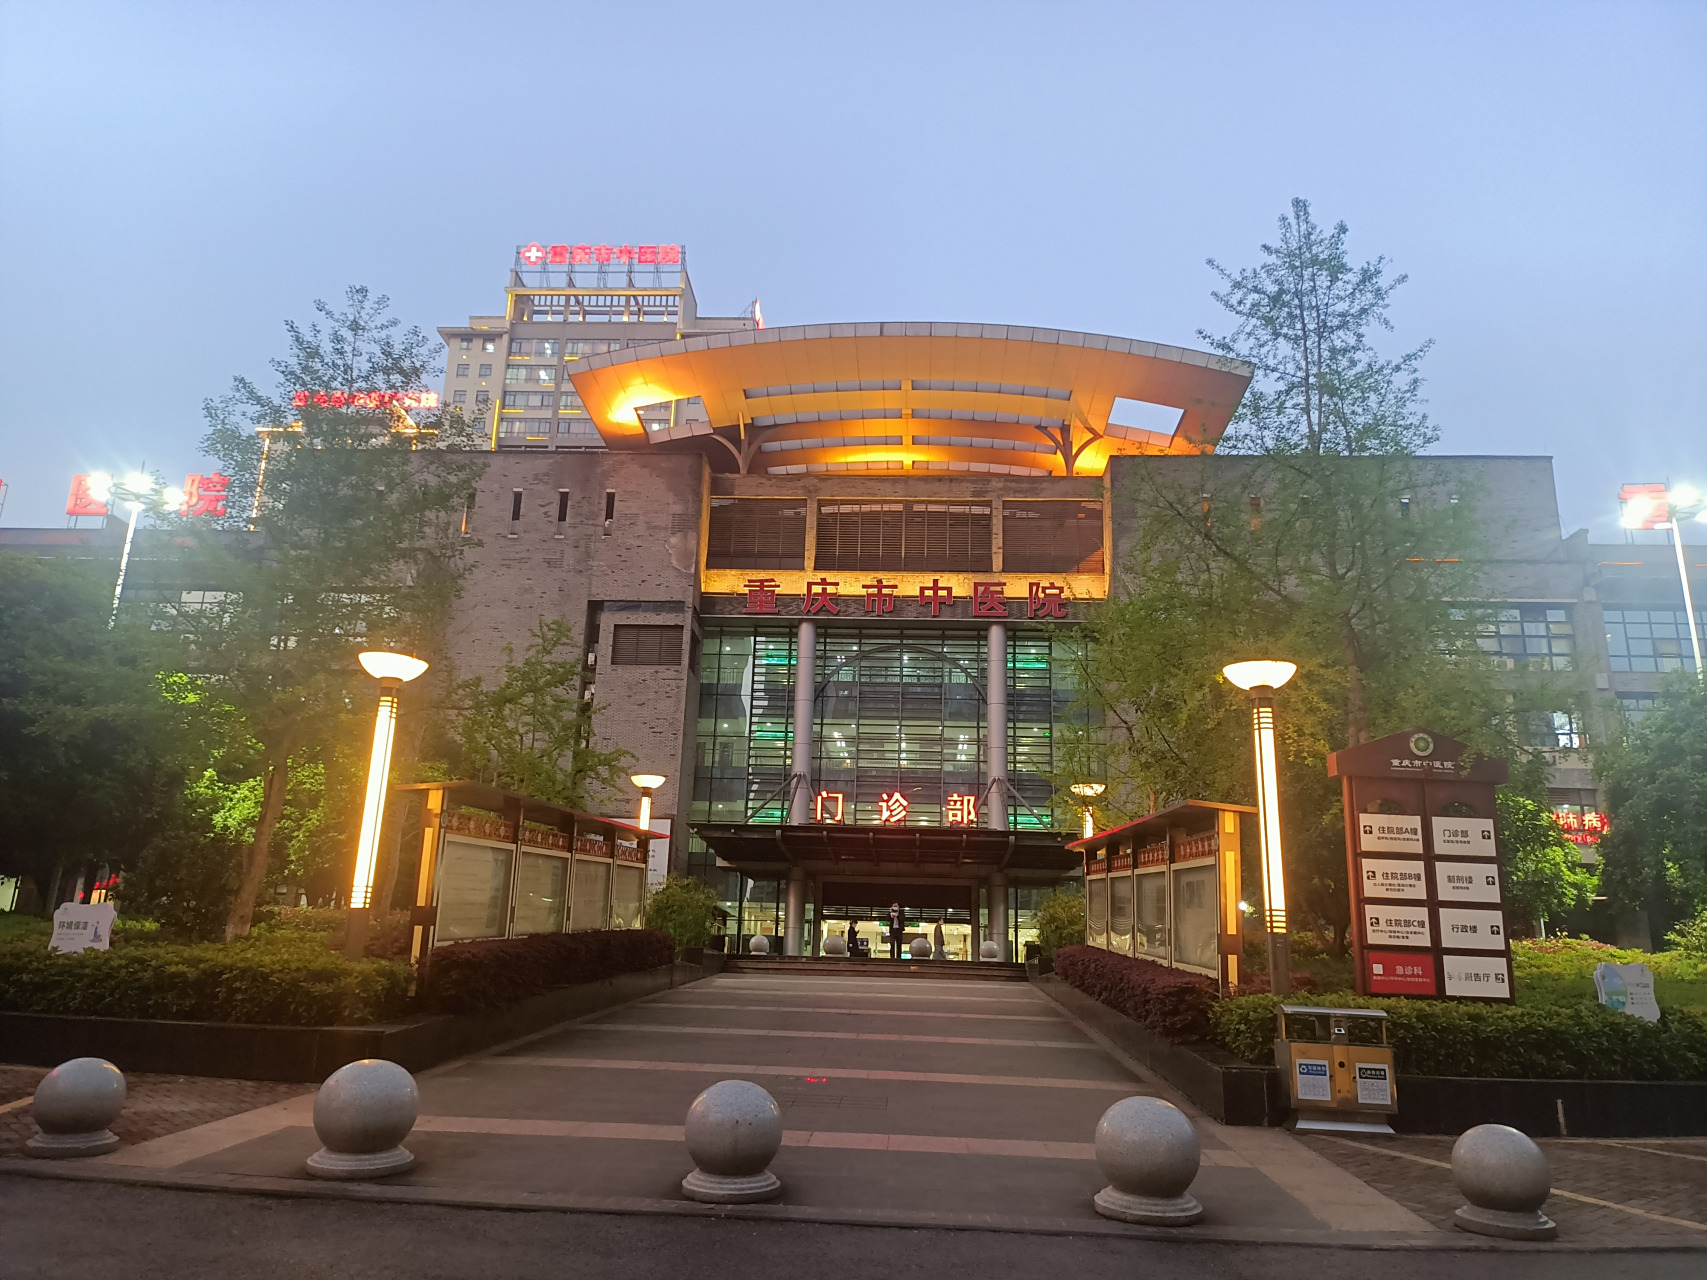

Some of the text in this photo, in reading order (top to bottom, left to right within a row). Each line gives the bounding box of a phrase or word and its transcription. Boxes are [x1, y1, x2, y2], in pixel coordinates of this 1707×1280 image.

[549, 244, 681, 264] 重庆市中医院
[743, 578, 1067, 618] 重庆市中医院
[815, 790, 978, 824] 门诊部
[1377, 825, 1419, 836] 住院部A幢
[1442, 829, 1470, 839] 门诊部
[1381, 871, 1422, 881] 住院部B幢
[1385, 918, 1426, 929] 住院部C幢
[1451, 923, 1478, 934] 行政楼
[1395, 965, 1423, 976] 急诊科
